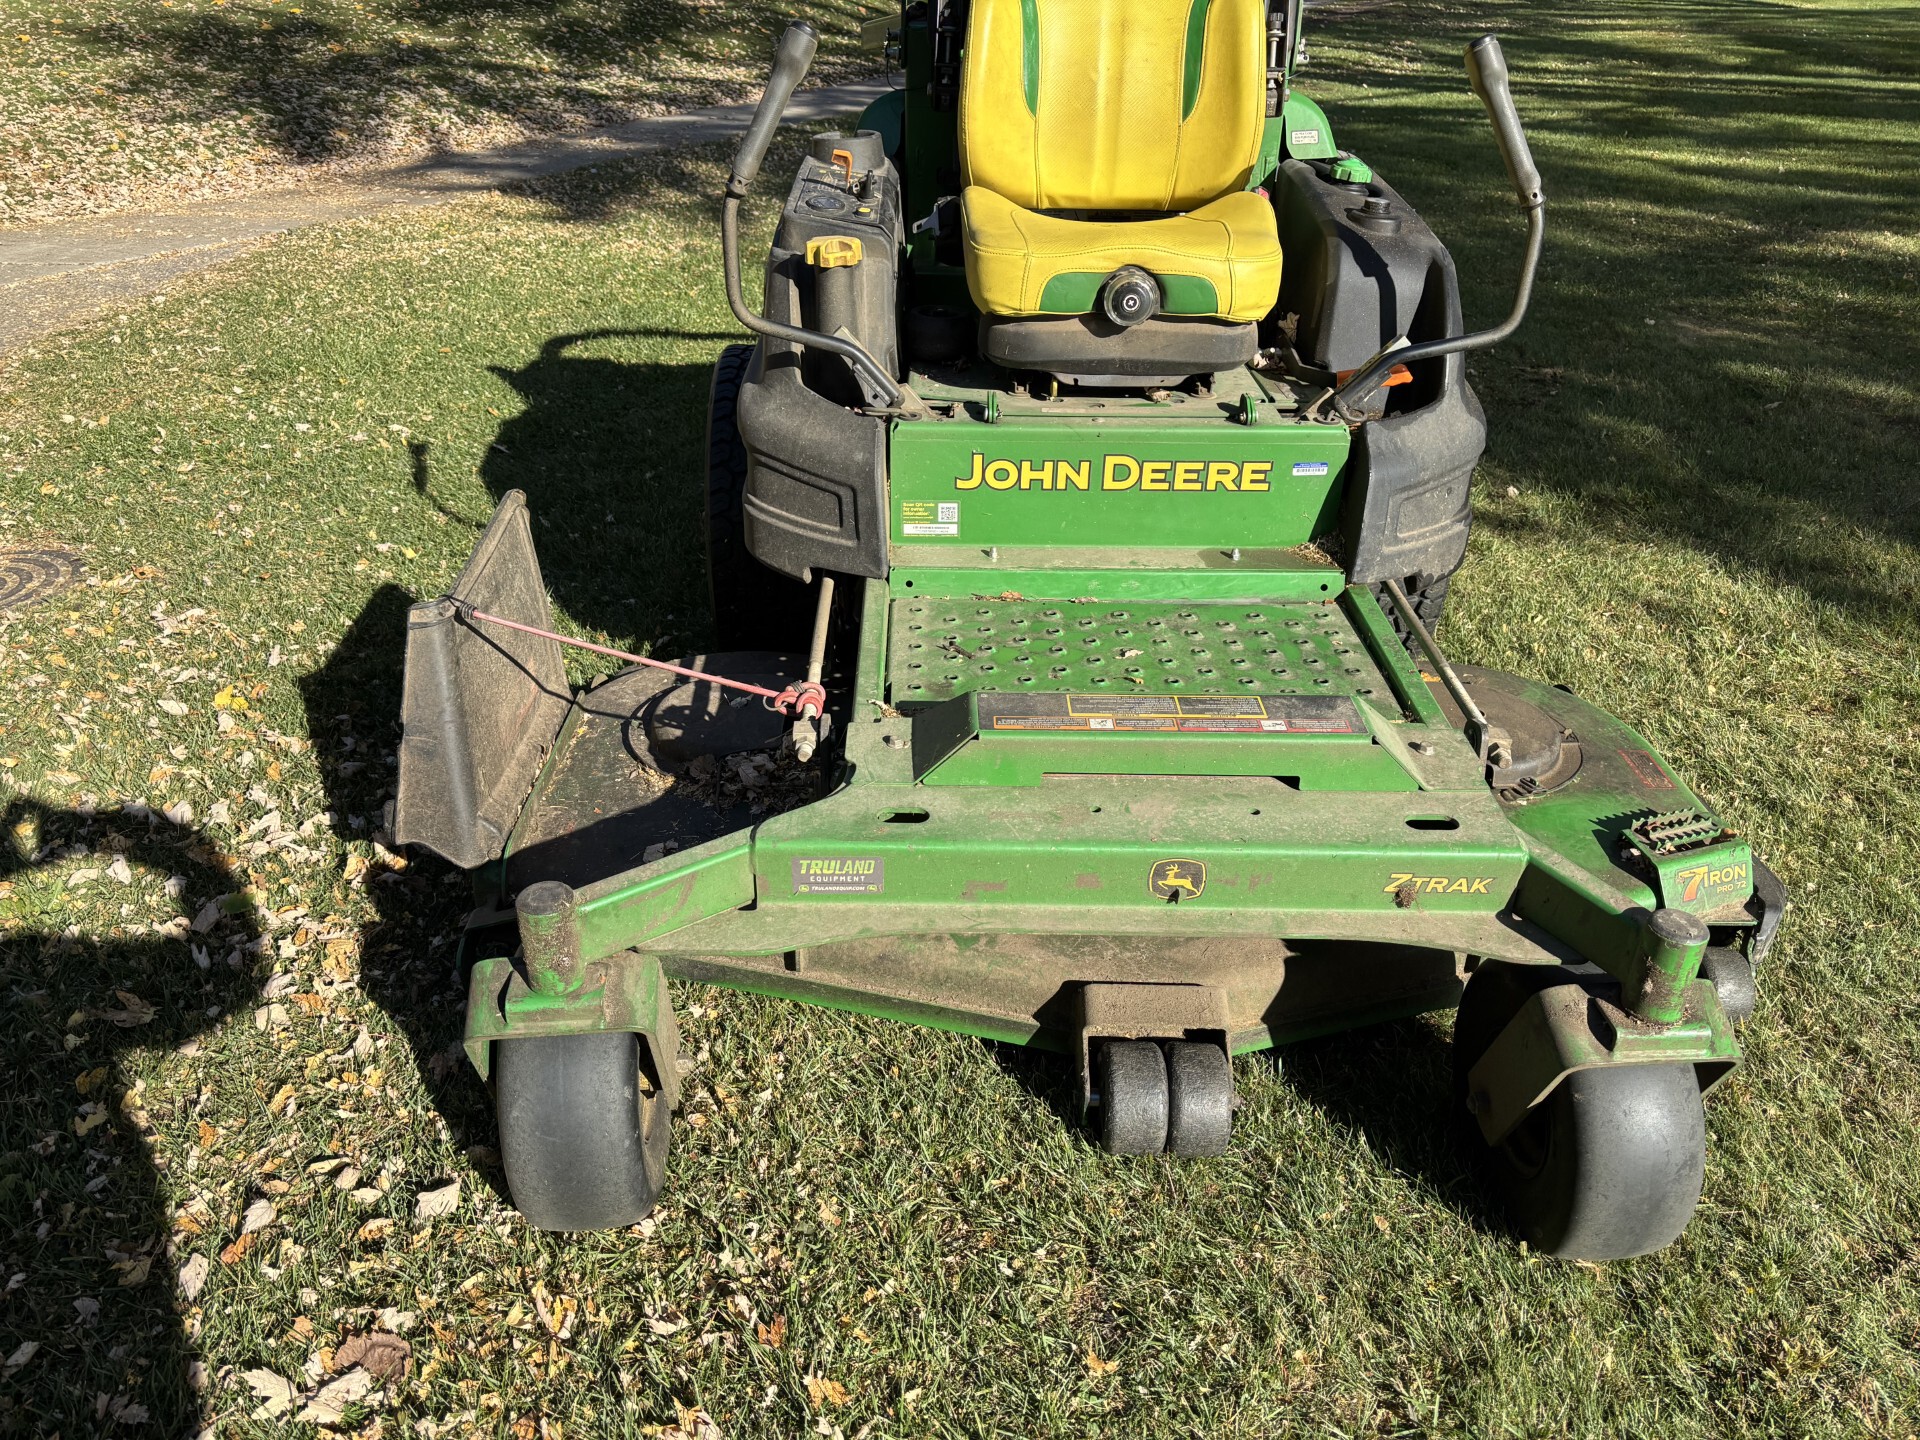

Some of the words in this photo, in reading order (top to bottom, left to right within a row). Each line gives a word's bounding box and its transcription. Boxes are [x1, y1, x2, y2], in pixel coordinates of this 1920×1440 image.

[955, 452, 1092, 491] JOHN
[1101, 453, 1273, 492] DEERE
[799, 859, 876, 875] TRULAND
[1716, 883, 1734, 894] PRO
[1735, 880, 1747, 889] 72
